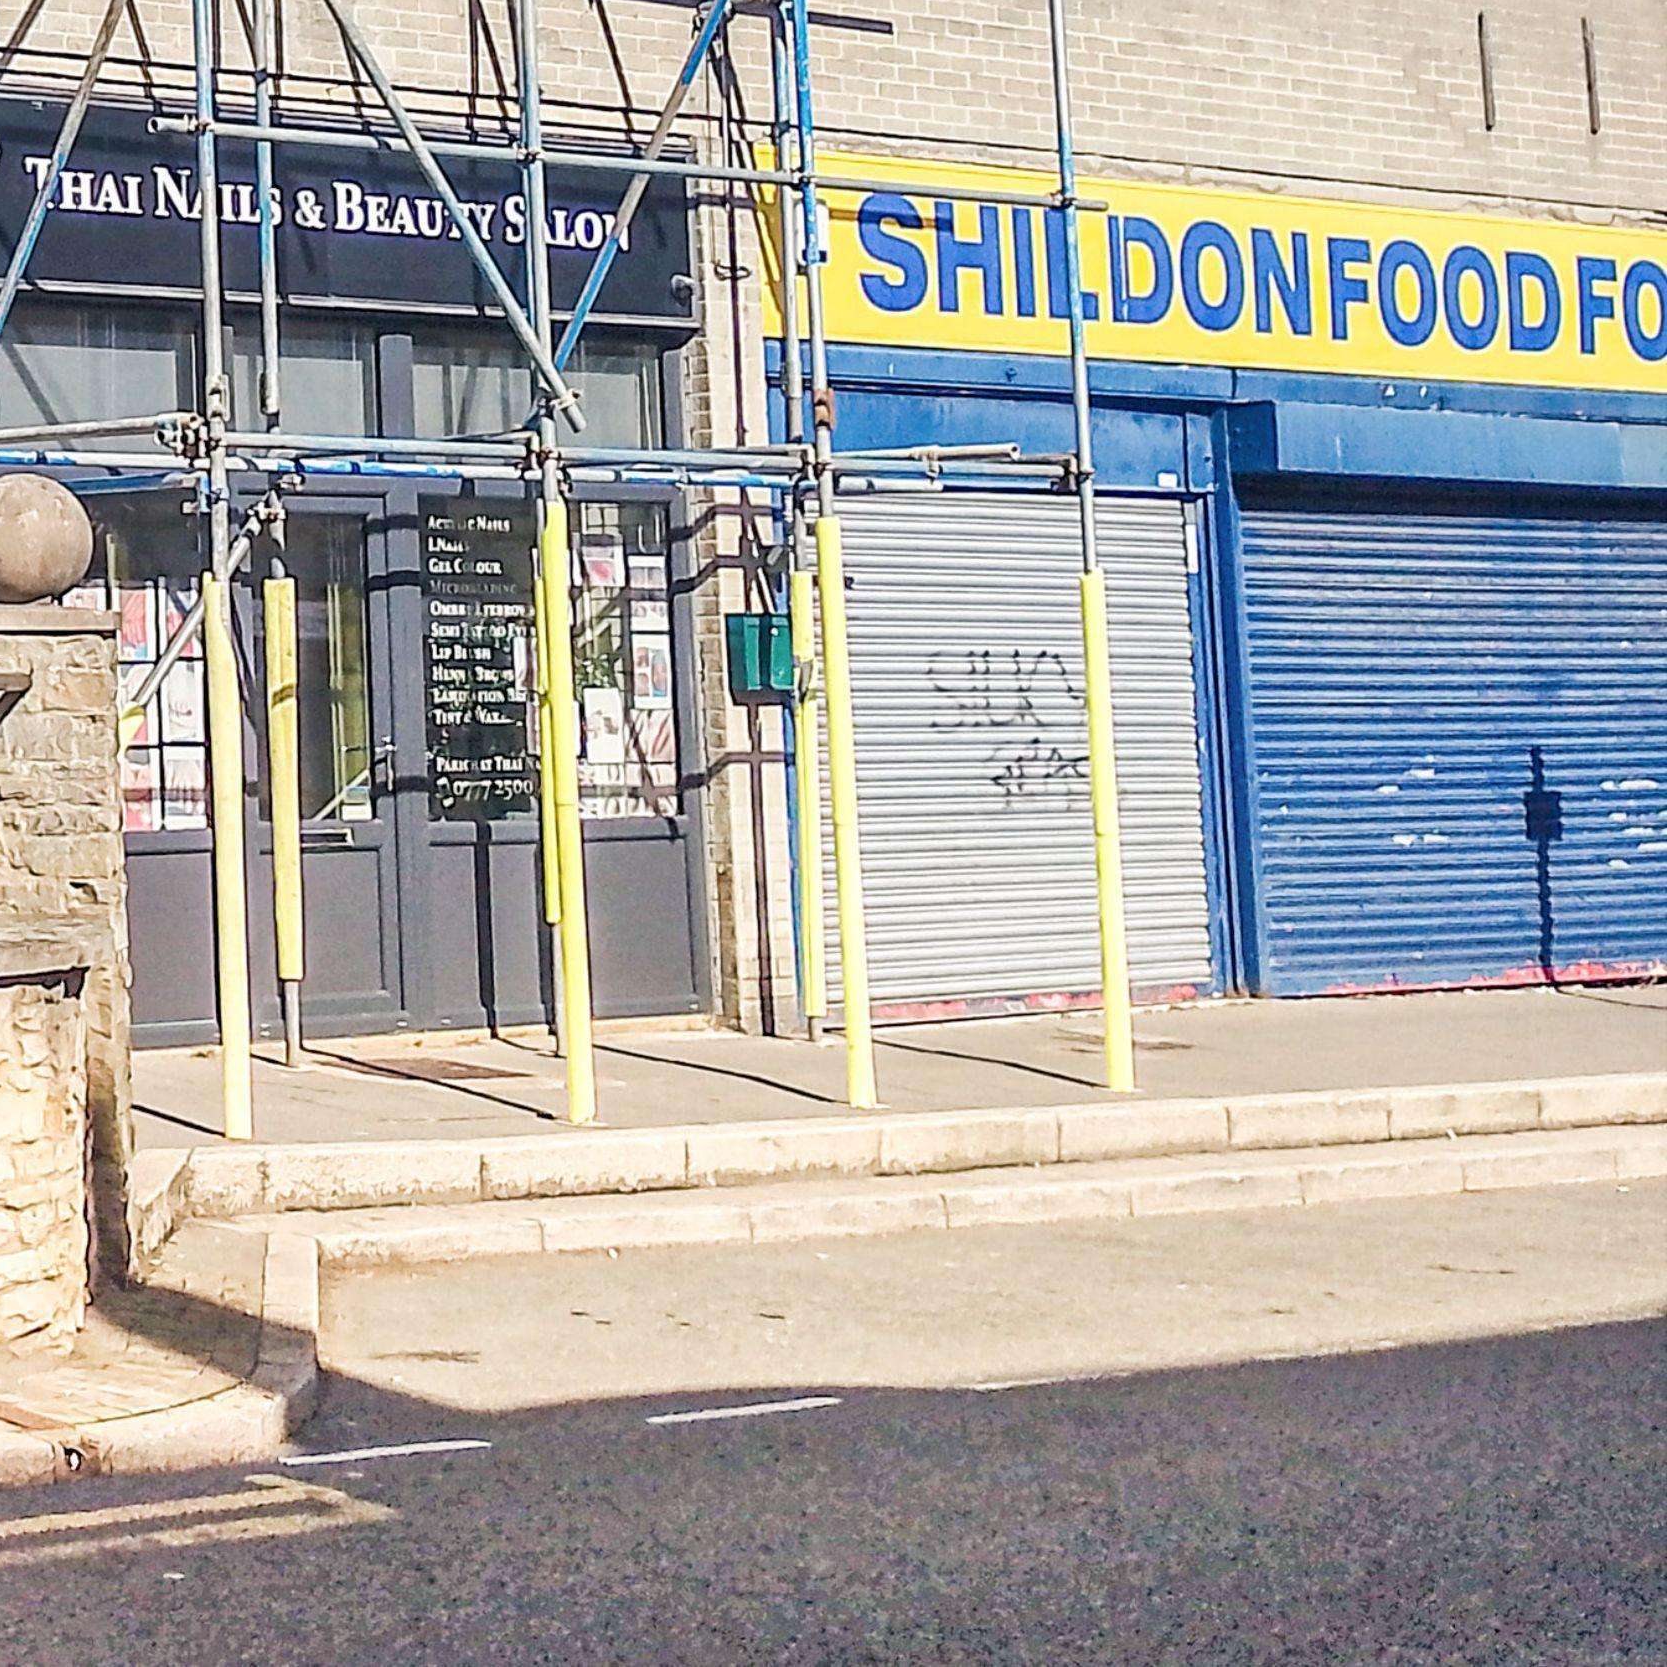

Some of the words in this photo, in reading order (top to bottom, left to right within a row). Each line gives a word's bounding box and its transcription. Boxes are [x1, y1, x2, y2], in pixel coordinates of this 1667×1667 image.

[23, 155, 144, 215] THAI
[294, 188, 327, 230] &
[503, 194, 630, 252] SLON
[857, 192, 1312, 336] SHILDON
[1327, 237, 1561, 352] FOOD
[453, 557, 503, 575] COUR
